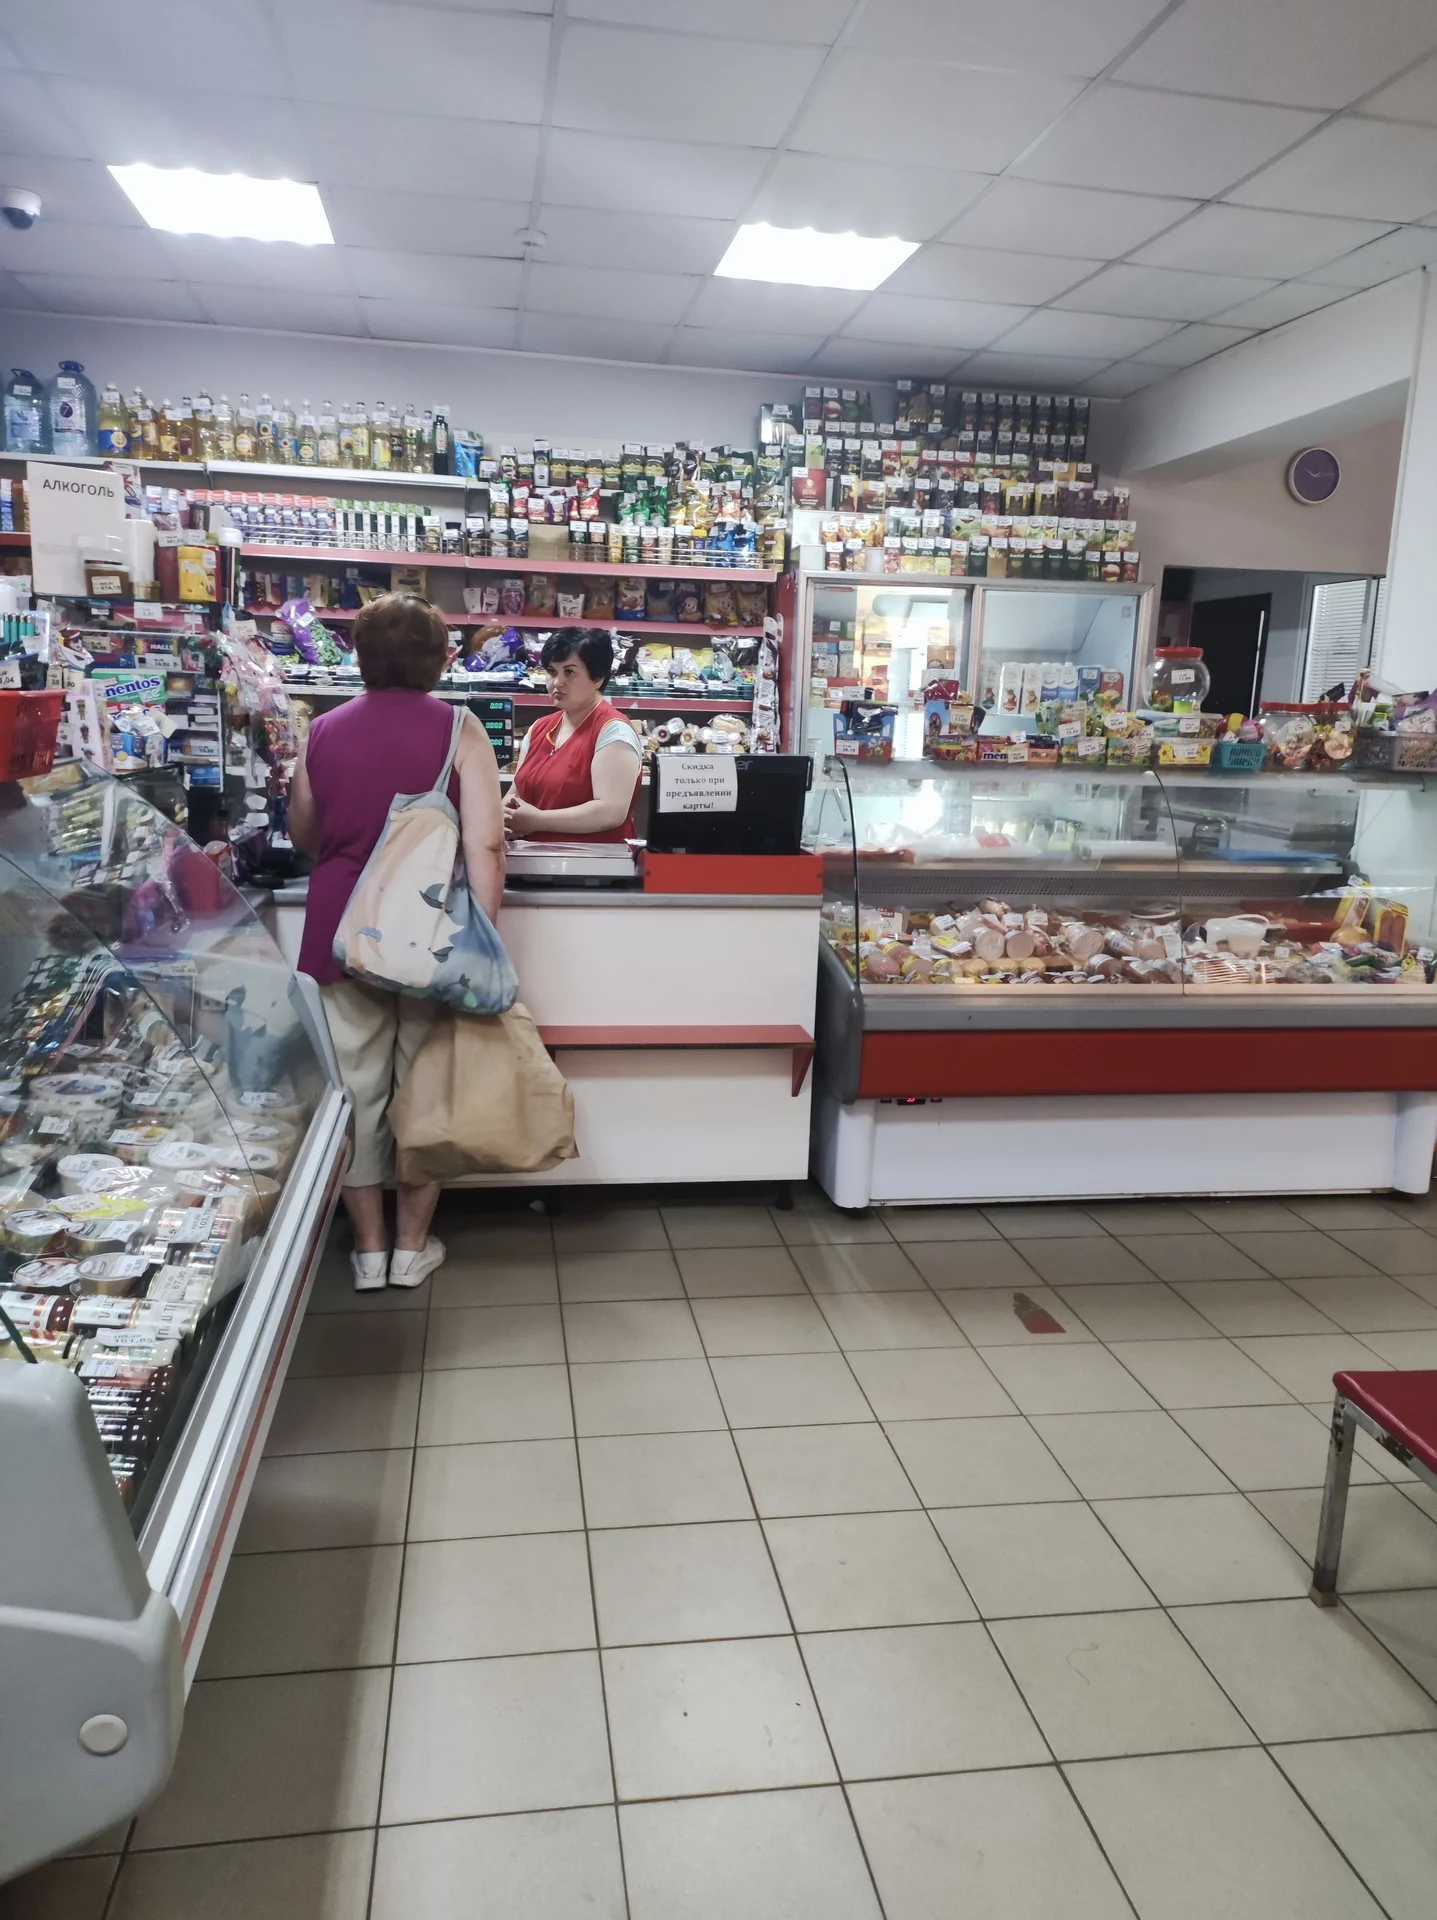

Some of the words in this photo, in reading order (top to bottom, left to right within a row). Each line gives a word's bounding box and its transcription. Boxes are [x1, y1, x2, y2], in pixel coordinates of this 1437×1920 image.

[43, 479, 115, 498] АЛКОГОЛЬ
[150, 643, 173, 651] HALLS
[736, 760, 754, 771] er
[708, 777, 725, 785] при
[665, 790, 732, 799] предъявлении
[682, 802, 714, 811] карты!
[199, 1208, 213, 1230] 103,79
[173, 1270, 187, 1290] 67,90
